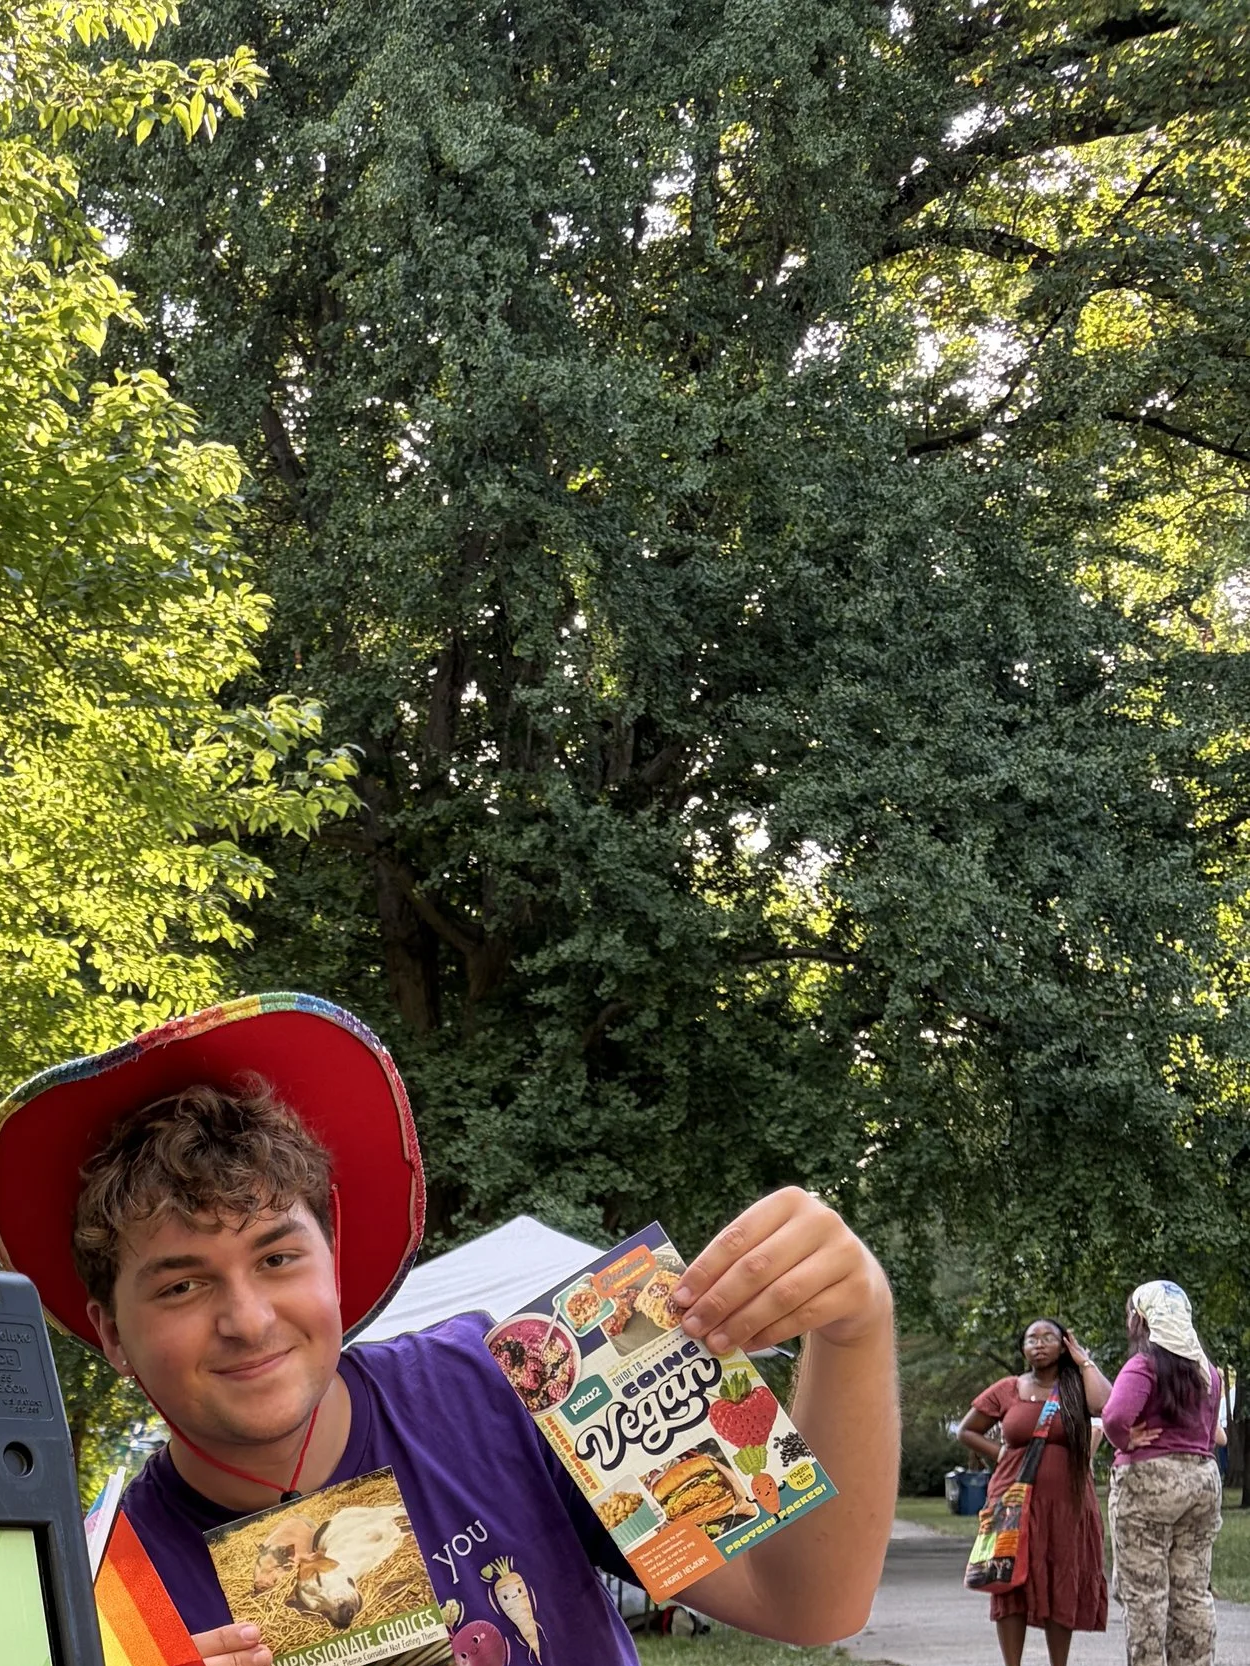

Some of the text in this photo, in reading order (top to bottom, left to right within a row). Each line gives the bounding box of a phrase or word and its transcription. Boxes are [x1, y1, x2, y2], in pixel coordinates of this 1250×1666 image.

[612, 1361, 644, 1387] GUIDE TO
[621, 1340, 700, 1400] GOING
[569, 1386, 602, 1416] peta2
[576, 1358, 721, 1470] Vegan
[796, 1474, 813, 1487] PLANTS
[725, 1483, 827, 1554] PROTEIN PACKED!
[432, 1520, 488, 1584] you
[376, 1609, 437, 1645] CHOICES
[363, 1647, 389, 1661] Consider
[389, 1643, 401, 1653] Not
[402, 1636, 422, 1648] Eating
[421, 1630, 439, 1641] Them
